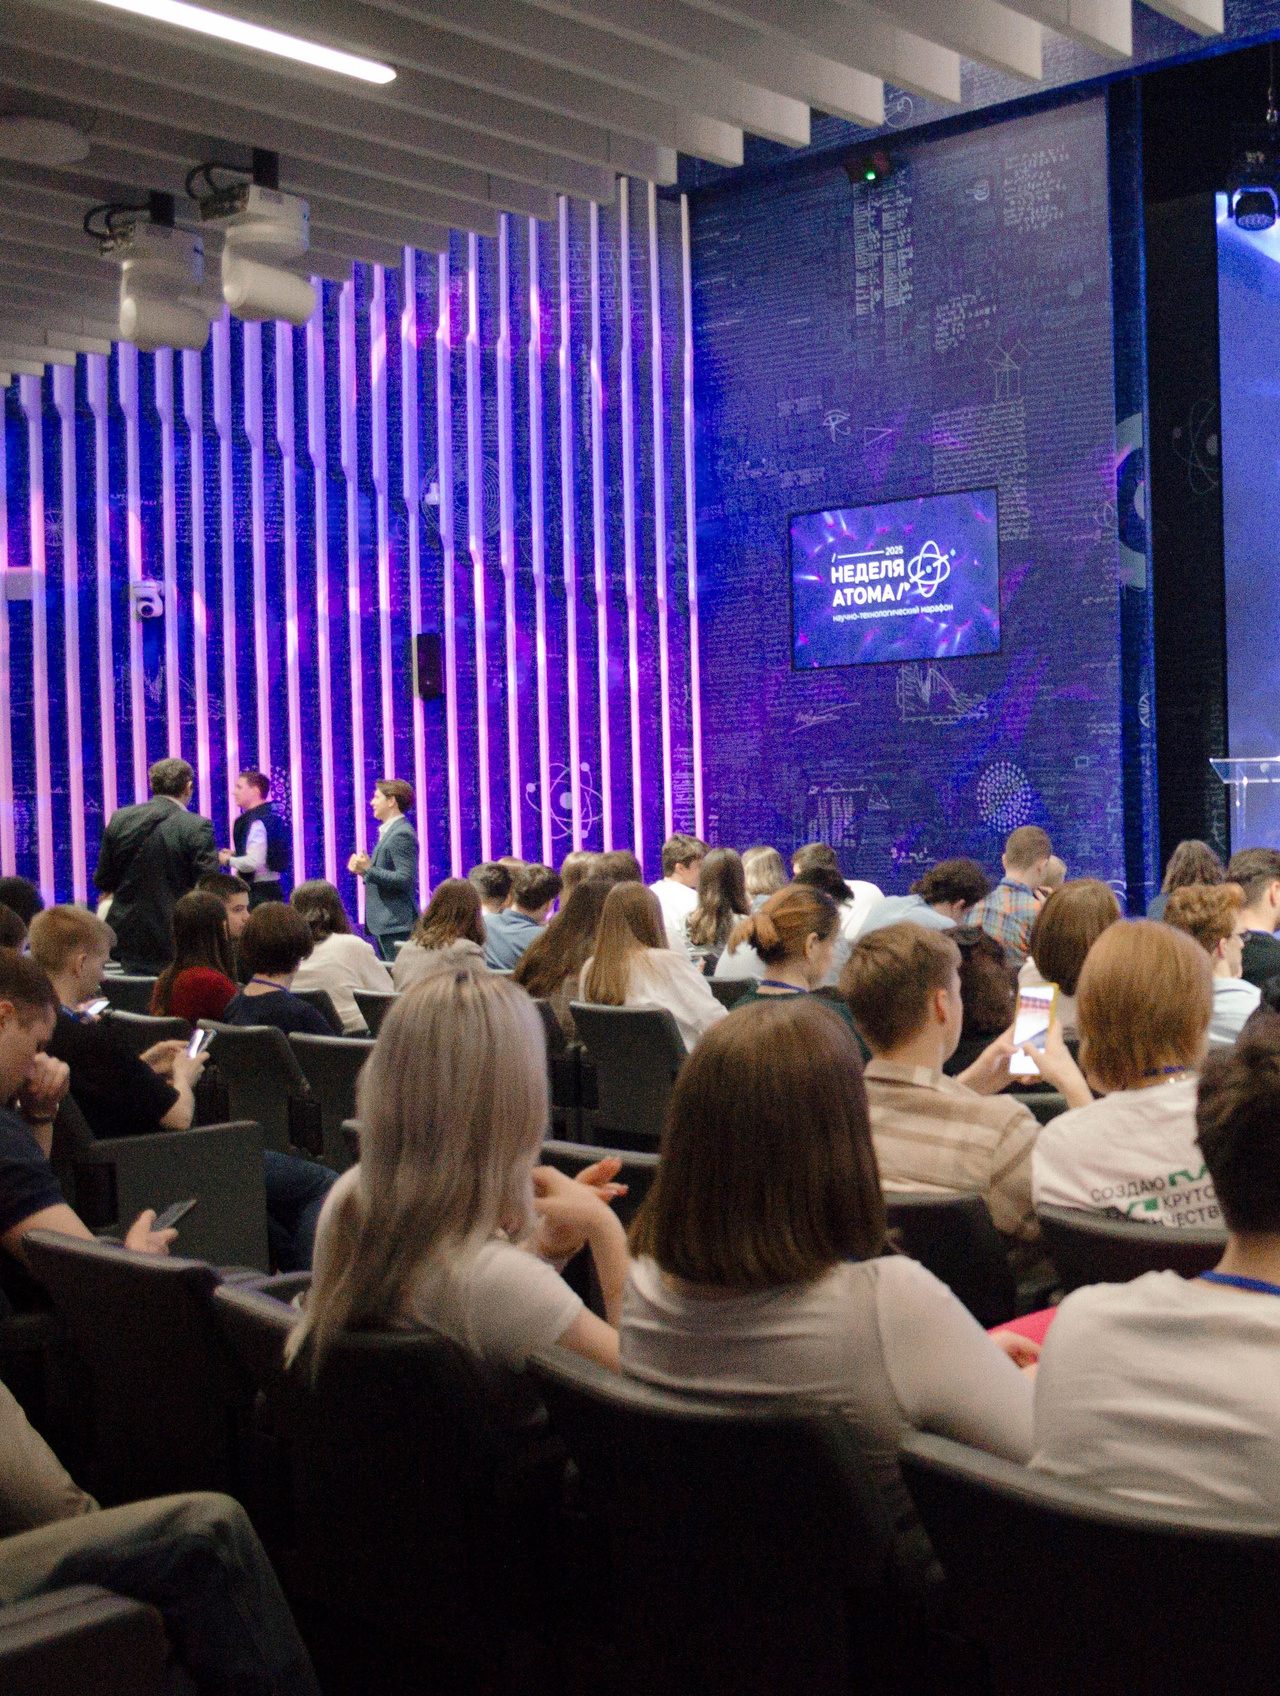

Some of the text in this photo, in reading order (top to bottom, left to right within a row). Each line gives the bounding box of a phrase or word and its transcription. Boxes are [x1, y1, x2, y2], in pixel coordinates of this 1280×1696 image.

[885, 546, 904, 556] 2025
[831, 559, 905, 584] НЕДЕЛЯ
[832, 604, 954, 623] научно-технологический марафон
[1091, 1176, 1165, 1202] СОЗДАЮ
